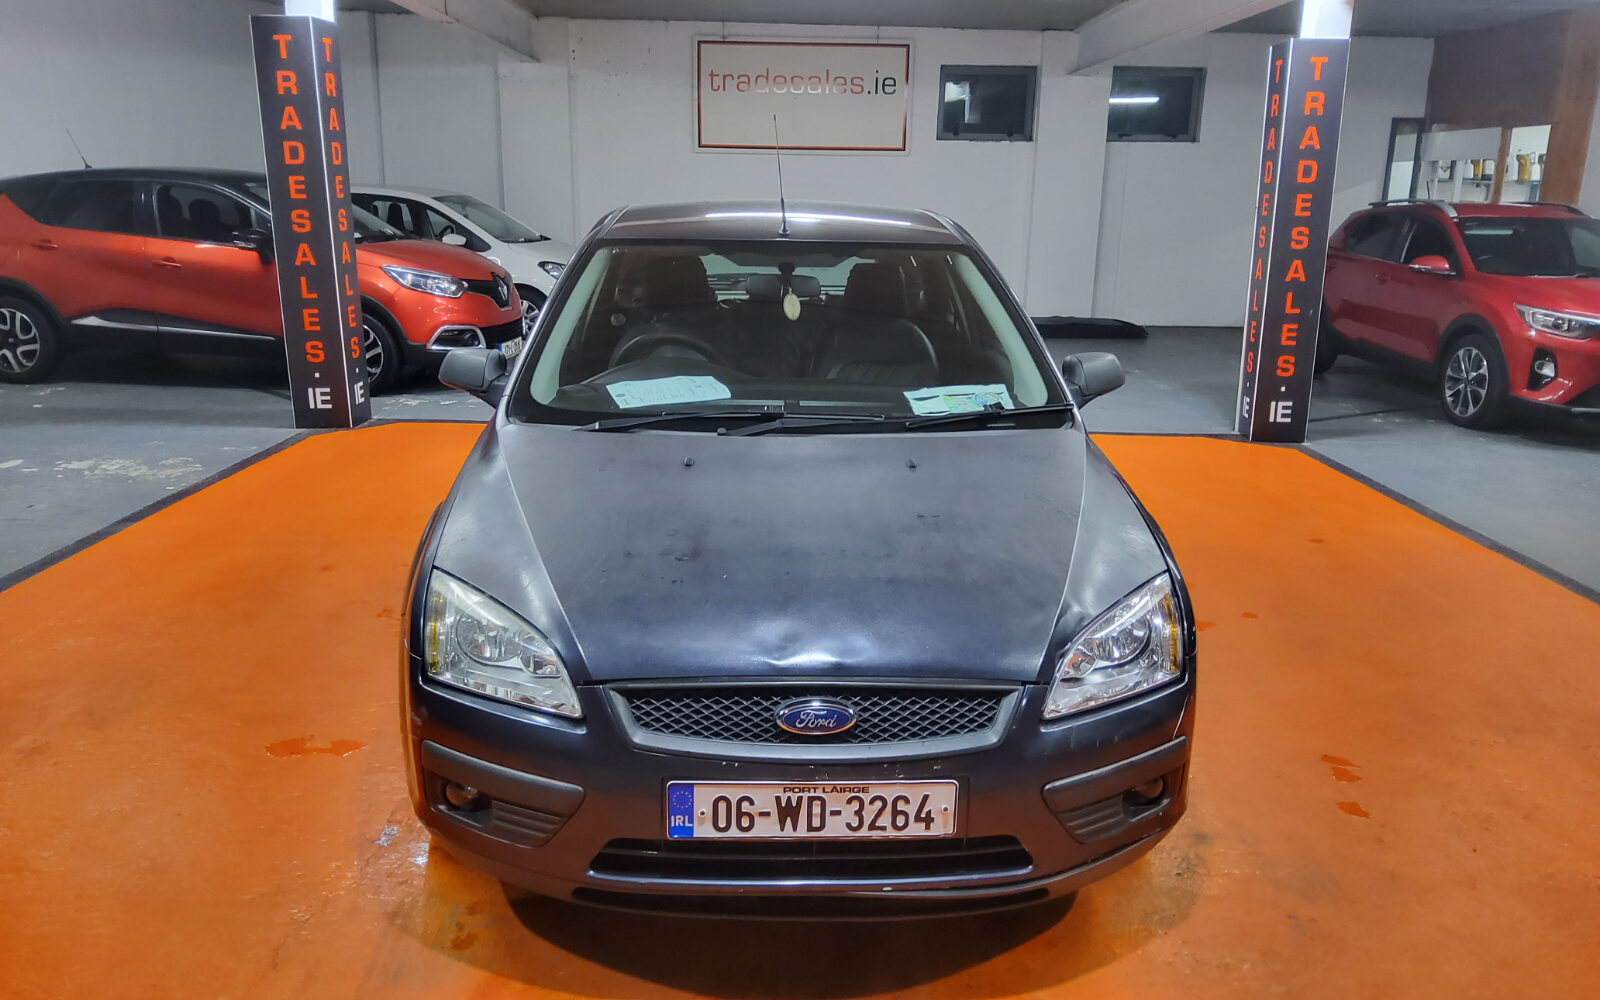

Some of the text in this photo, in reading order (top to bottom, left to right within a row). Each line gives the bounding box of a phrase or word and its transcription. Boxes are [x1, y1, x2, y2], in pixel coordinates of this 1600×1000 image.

[708, 67, 897, 95] tradesales.ie
[795, 709, 838, 728] Ford
[783, 786, 819, 794] PORT
[670, 815, 694, 827] IRL
[712, 793, 935, 833] 06-WD-3264
